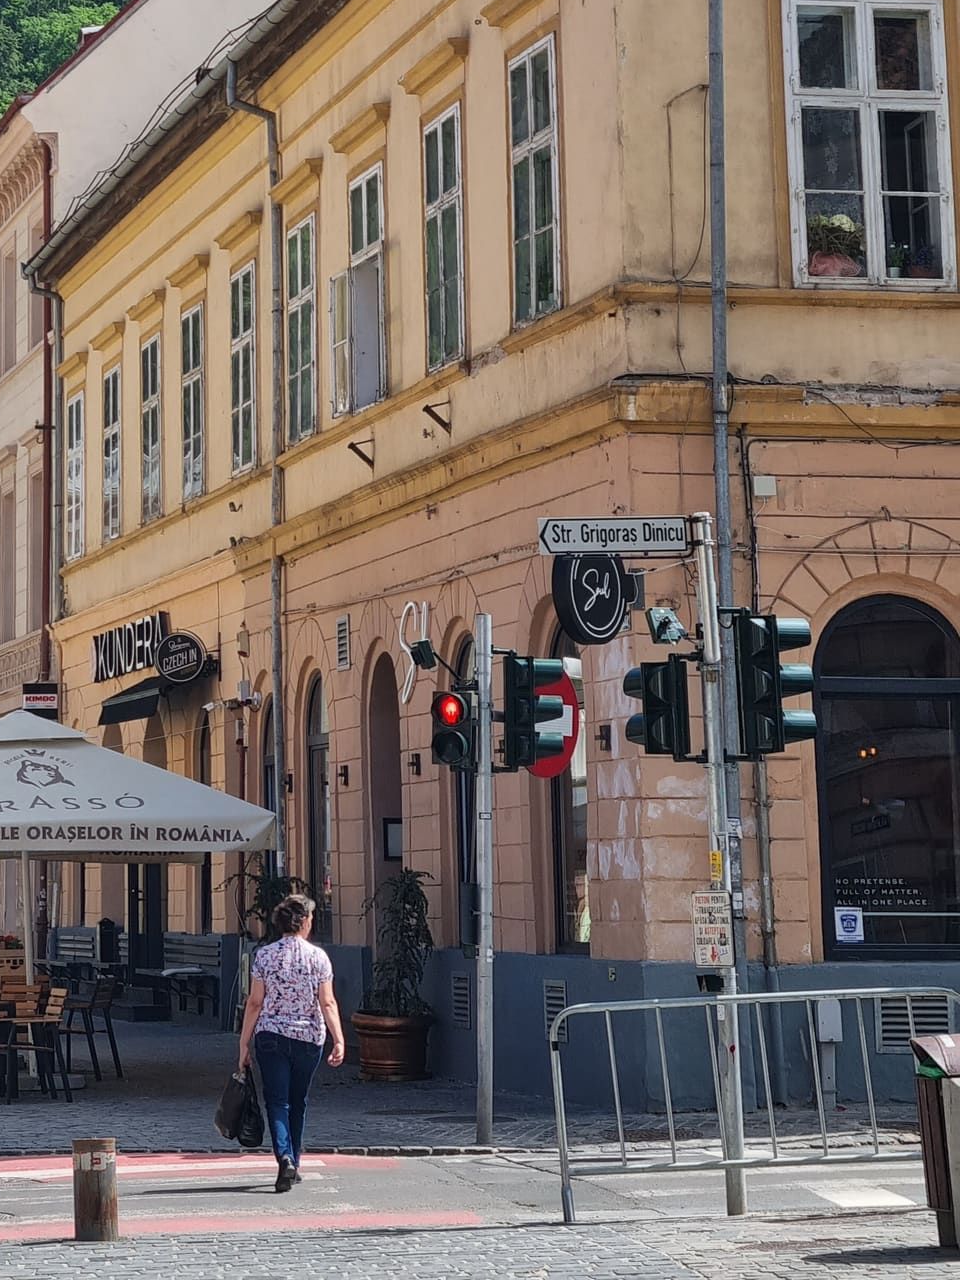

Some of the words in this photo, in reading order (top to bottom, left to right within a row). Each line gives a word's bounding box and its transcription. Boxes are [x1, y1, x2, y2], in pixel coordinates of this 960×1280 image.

[551, 525, 576, 543] Str.
[643, 523, 684, 542] Dinicu
[98, 611, 163, 682] KUNDERA
[163, 650, 188, 672] CZECH
[27, 826, 122, 843] ORAȘELOR
[130, 823, 149, 840] ÎN
[156, 825, 250, 843] ROMÂNIA.
